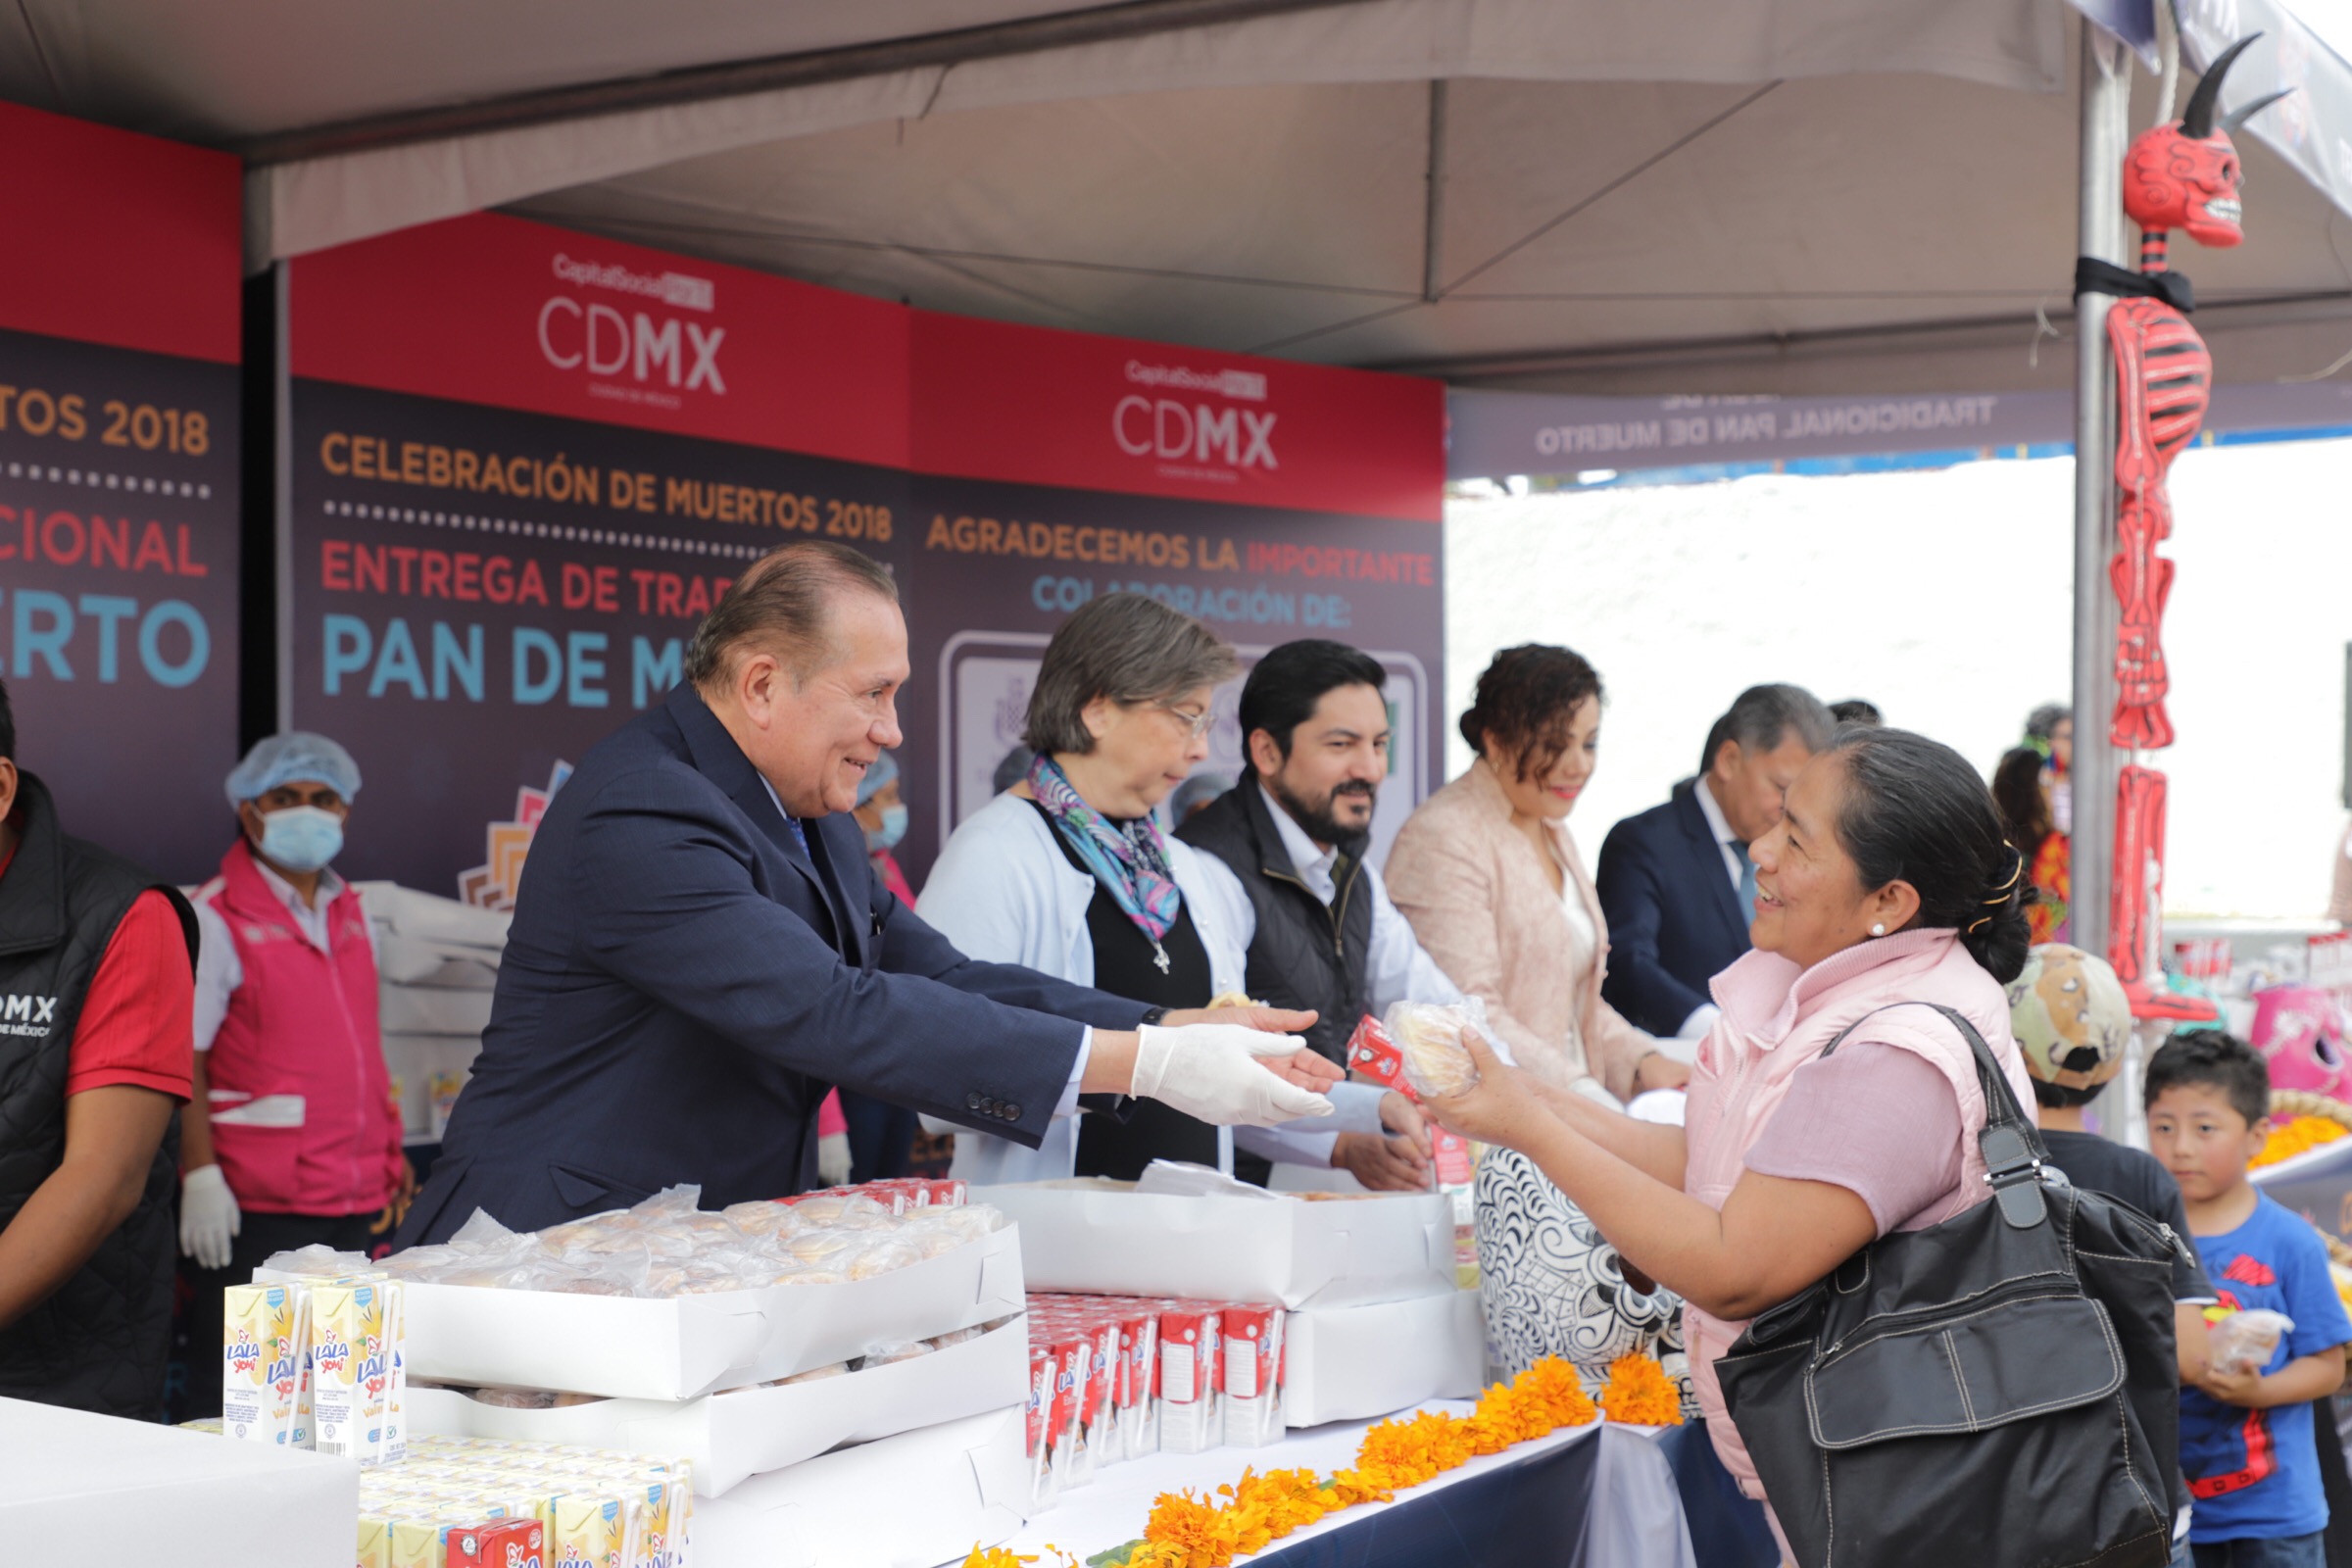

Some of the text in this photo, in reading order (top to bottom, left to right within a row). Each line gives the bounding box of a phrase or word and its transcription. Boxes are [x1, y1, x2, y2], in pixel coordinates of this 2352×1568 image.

[538, 296, 726, 396] CDMX
[102, 400, 209, 457] 2018
[1113, 395, 1278, 470] CDMX
[320, 431, 892, 542] CELEBRACIÓN DE MUERTOS 2018
[321, 541, 549, 607] ENTREGA
[562, 562, 619, 612] DE
[926, 514, 1435, 586] AGRADECEMOS LA IMPORTANTE
[0, 586, 211, 688] RTO
[323, 612, 484, 704] PAN
[513, 627, 610, 708] DE
[226, 1343, 260, 1360] LALA
[315, 1343, 349, 1360] LALA
